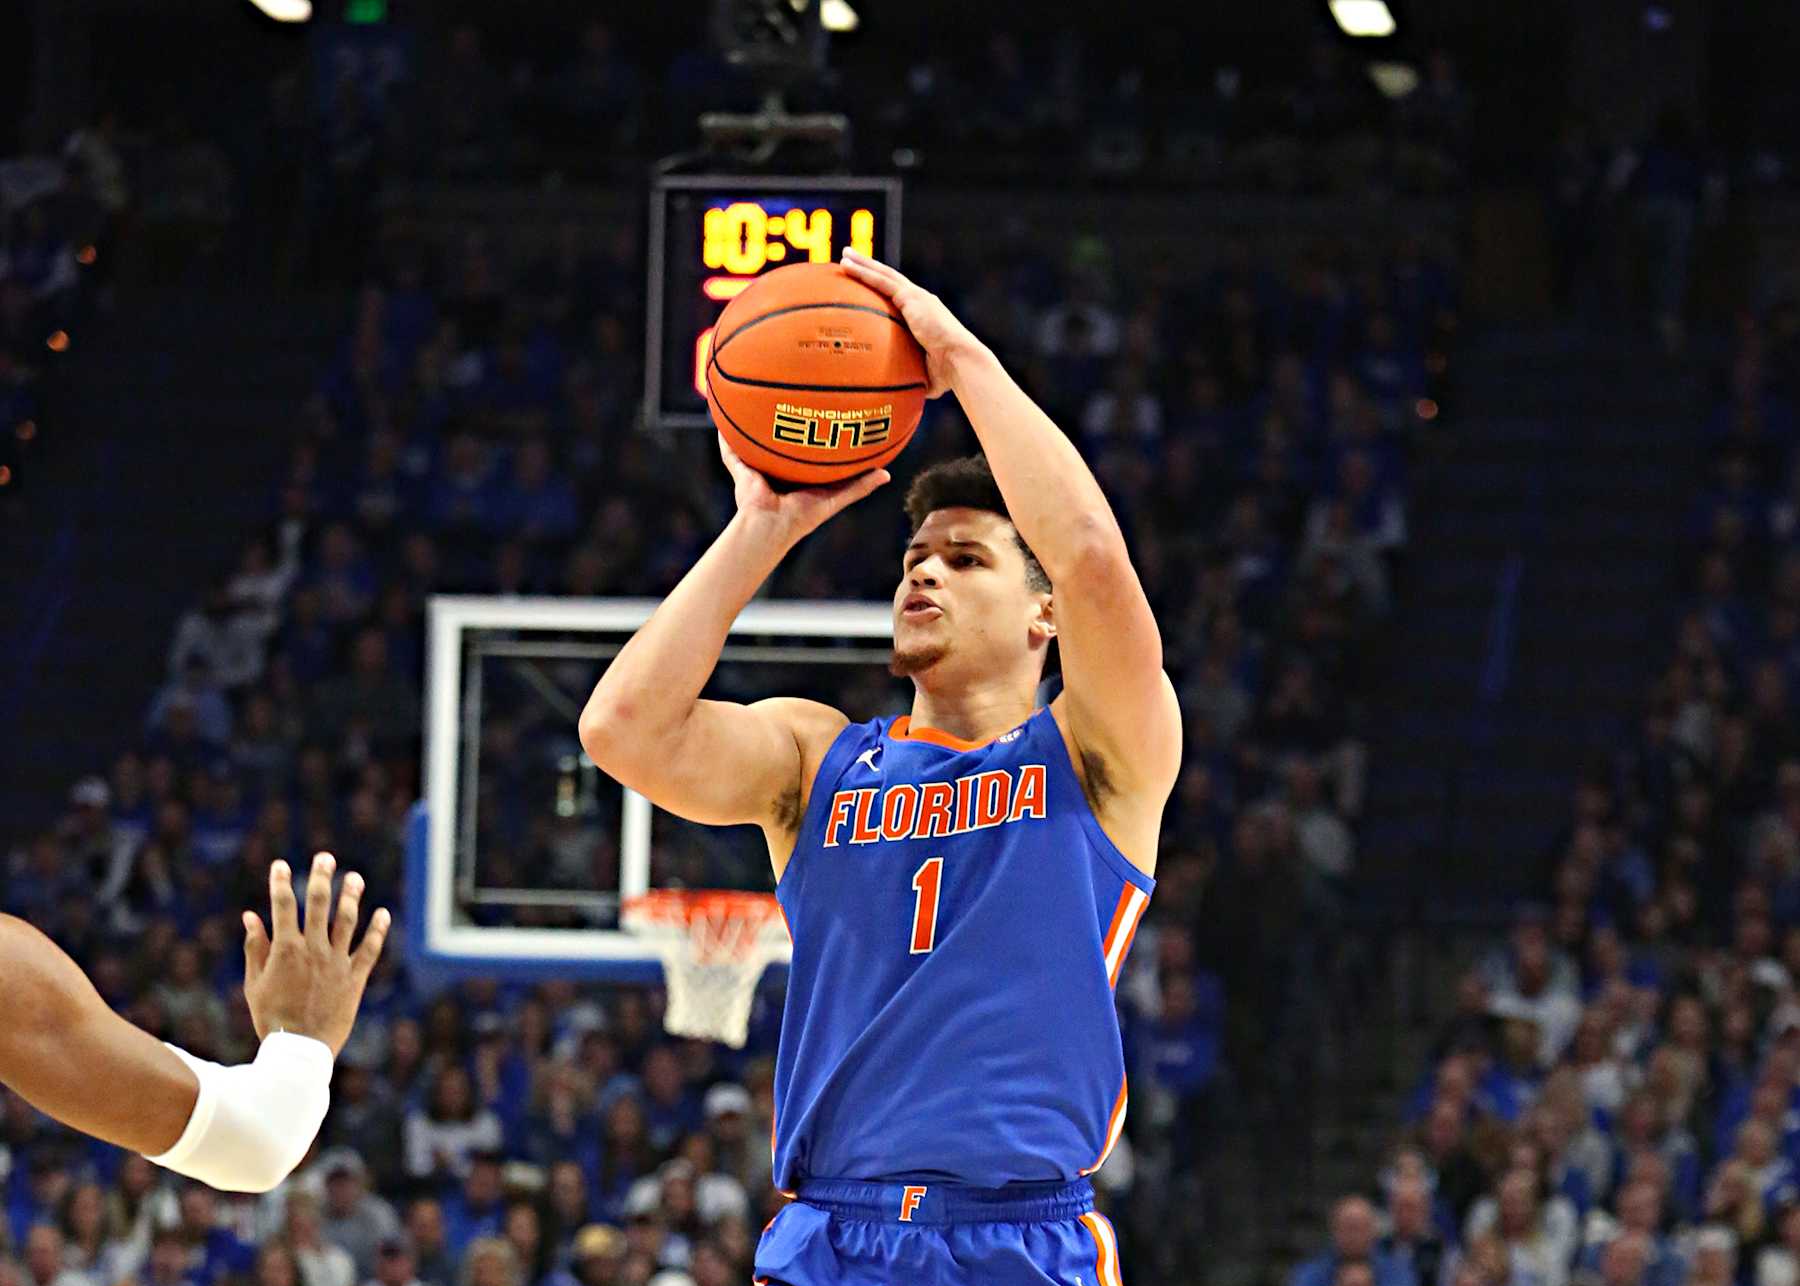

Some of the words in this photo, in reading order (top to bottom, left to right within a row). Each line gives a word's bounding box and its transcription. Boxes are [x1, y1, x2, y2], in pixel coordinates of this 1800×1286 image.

[703, 203, 873, 274] 10:41
[772, 412, 891, 449] ELITE
[775, 403, 893, 420] CHAMPIONSHIP
[823, 764, 1047, 848] FLORIDA
[909, 857, 943, 954] 1
[898, 1186, 927, 1221] F
